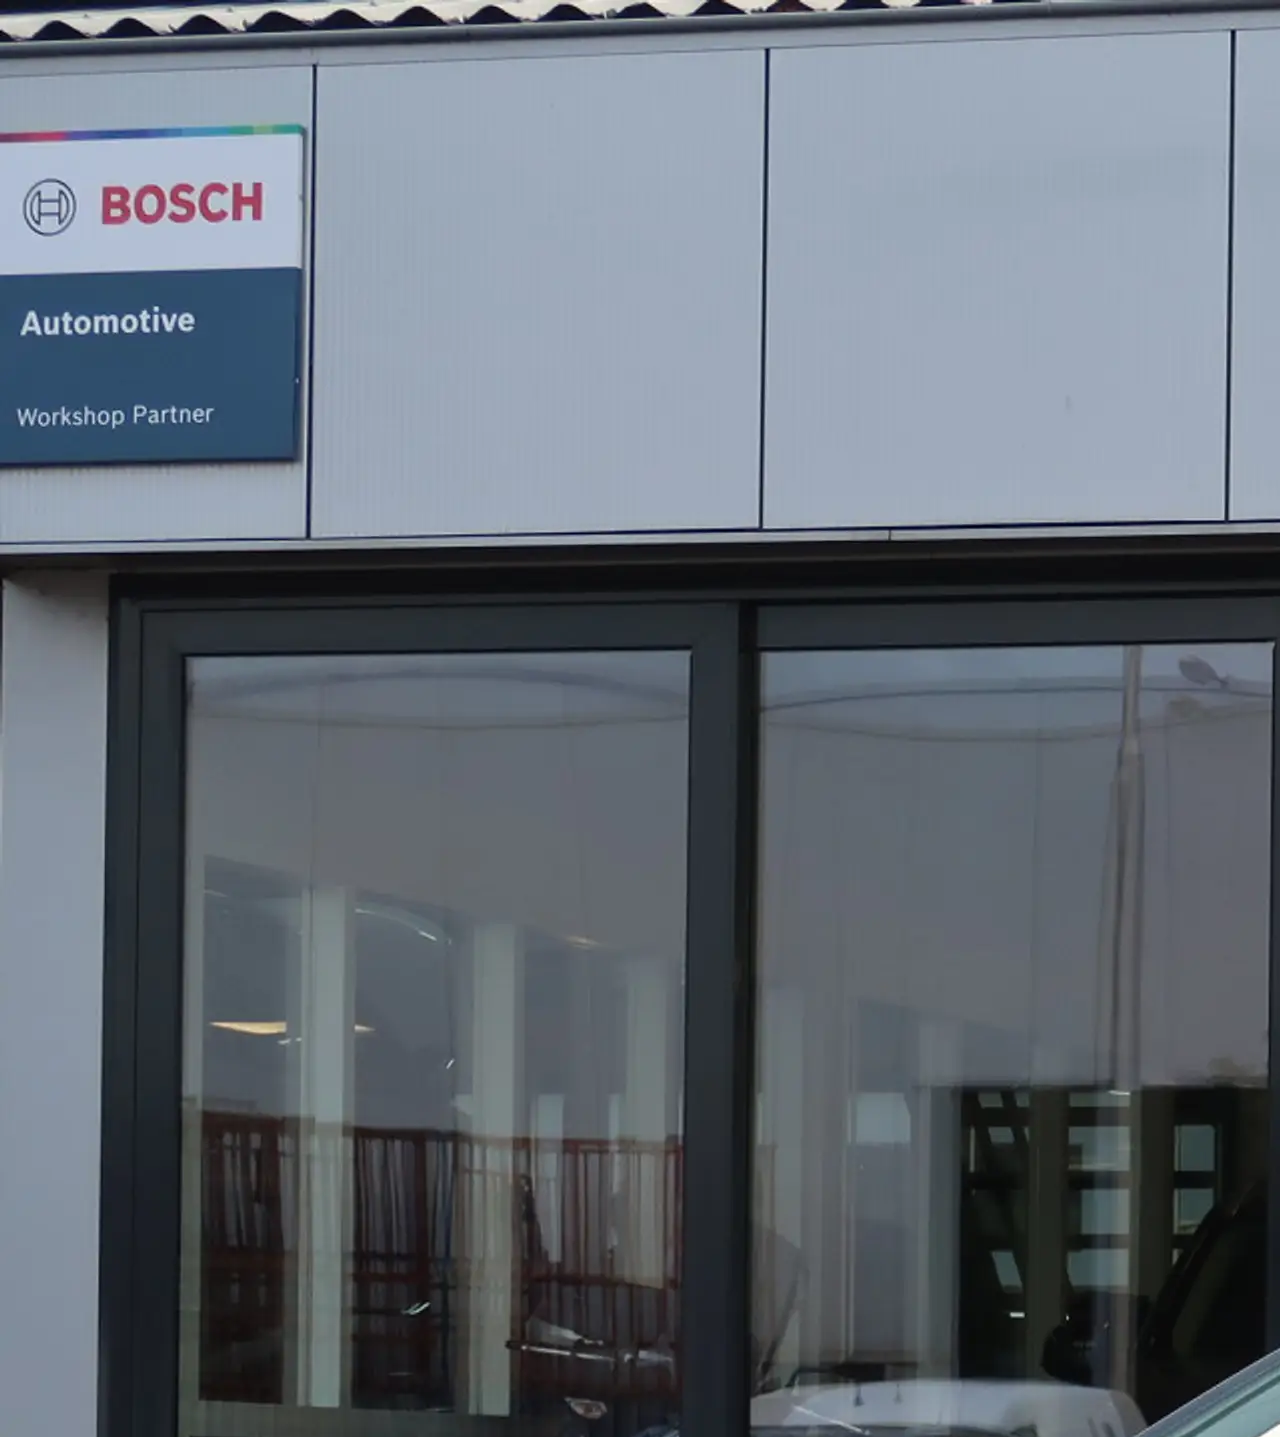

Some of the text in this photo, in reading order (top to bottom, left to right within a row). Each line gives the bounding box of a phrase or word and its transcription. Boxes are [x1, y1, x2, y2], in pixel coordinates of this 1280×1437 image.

[102, 181, 263, 225] BOSCH
[20, 305, 196, 336] Automotive
[17, 404, 214, 429] Workshop Partner
